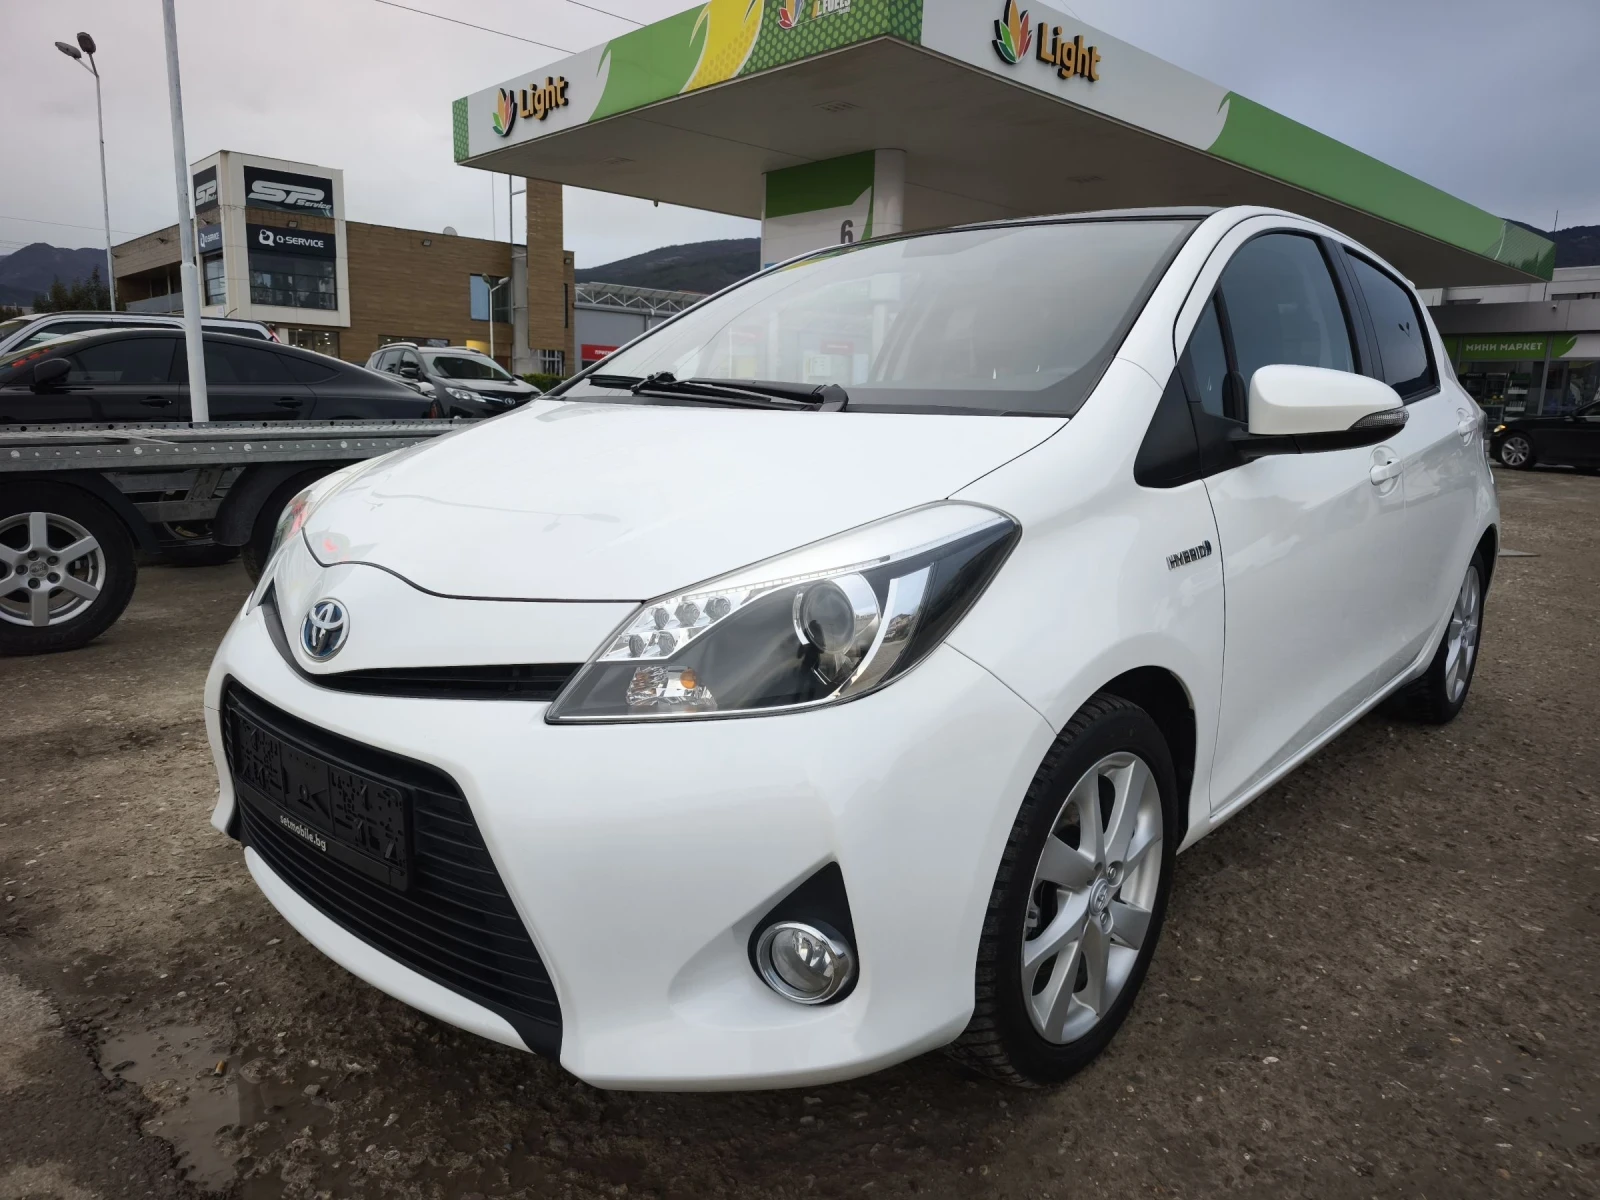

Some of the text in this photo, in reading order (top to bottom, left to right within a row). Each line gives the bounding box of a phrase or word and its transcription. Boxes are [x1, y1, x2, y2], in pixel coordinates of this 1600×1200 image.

[1036, 22, 1101, 82] Light
[519, 76, 569, 121] Light
[195, 180, 217, 206] SP
[247, 180, 325, 204] SP
[295, 199, 332, 210] Service
[840, 219, 854, 245] 6
[1465, 342, 1543, 352] МИНИ МАРКЕТ
[1165, 544, 1208, 571] HYBRID
[279, 815, 327, 852] setmobile.bg
